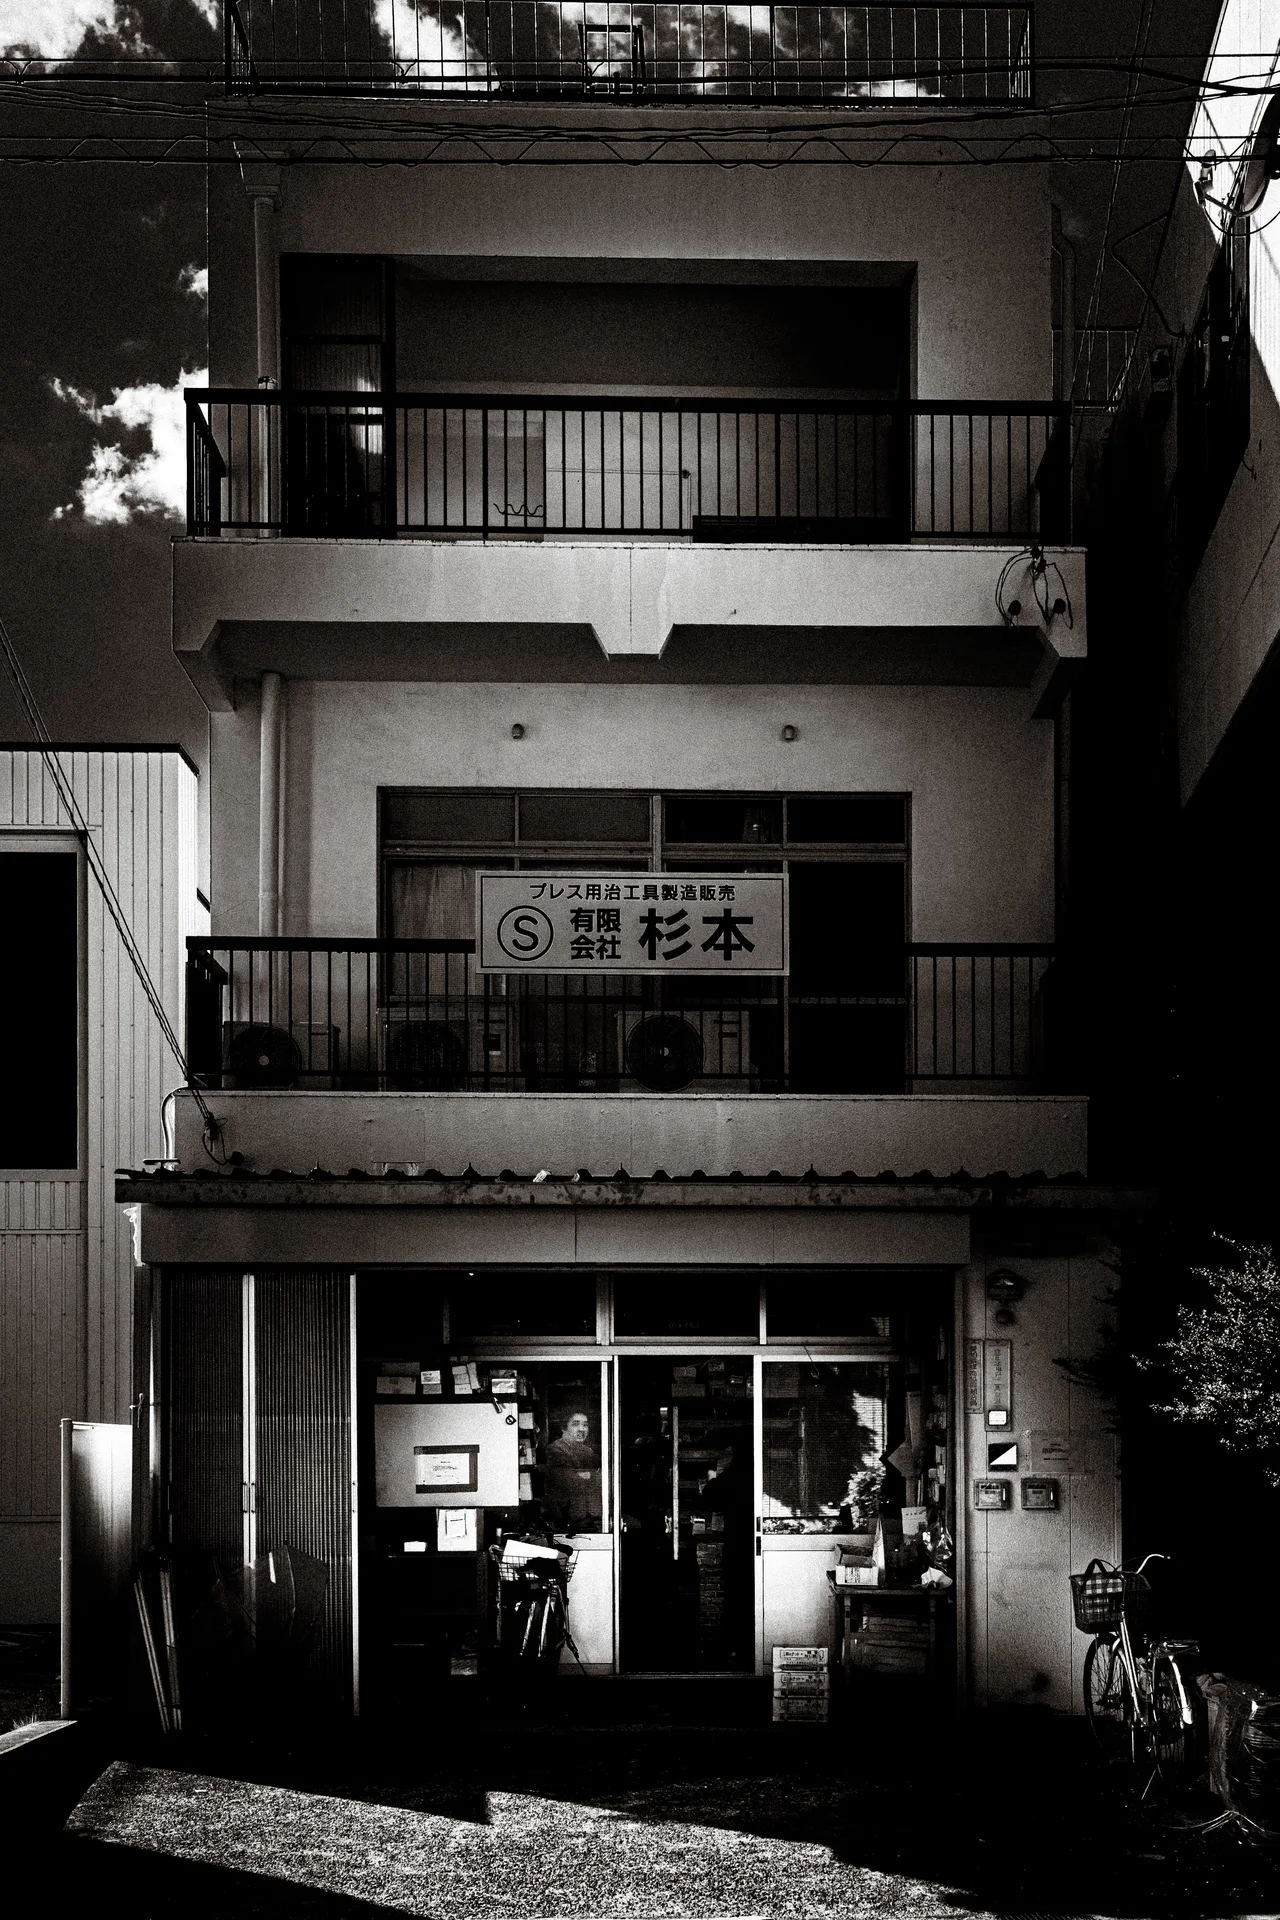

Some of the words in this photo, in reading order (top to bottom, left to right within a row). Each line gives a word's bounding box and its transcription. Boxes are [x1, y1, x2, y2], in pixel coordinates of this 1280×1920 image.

[530, 884, 736, 901] プレス用治工具製造販売
[570, 908, 622, 933] 有限
[638, 908, 756, 961] 杉本
[570, 935, 622, 960] 会社
